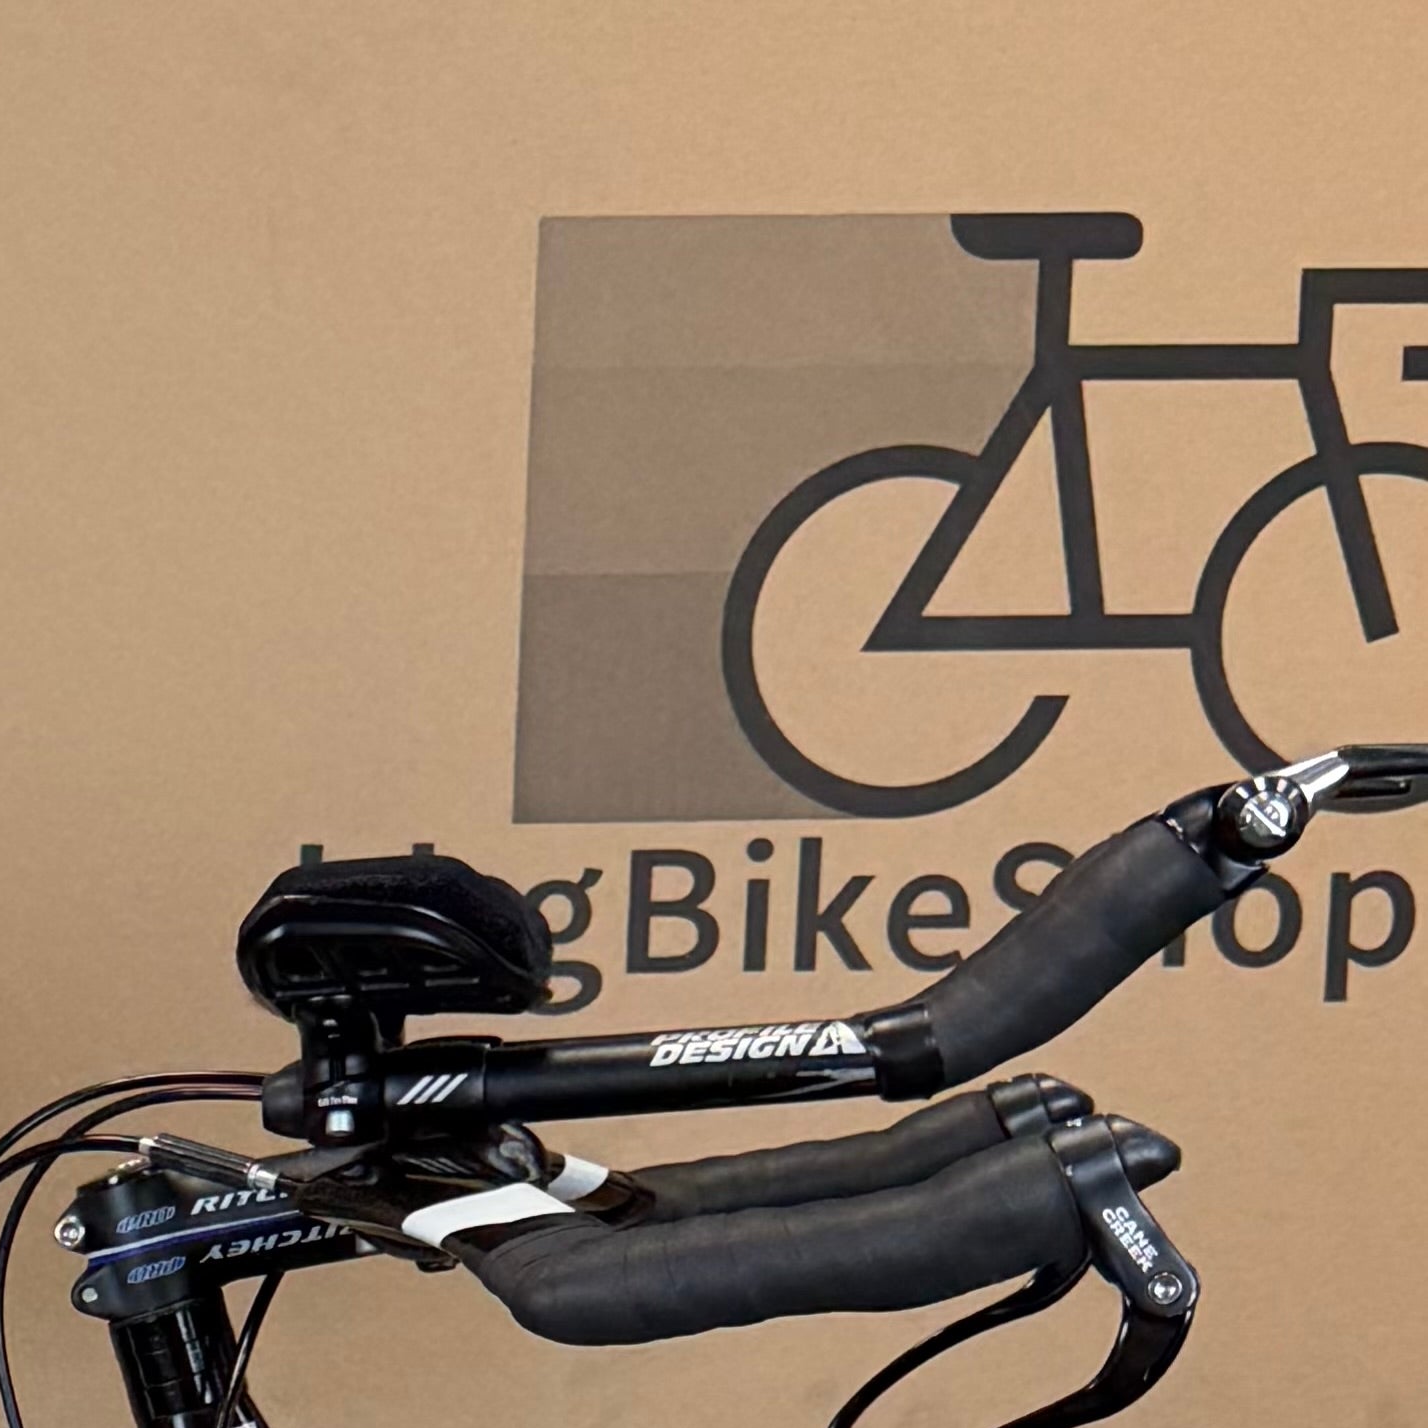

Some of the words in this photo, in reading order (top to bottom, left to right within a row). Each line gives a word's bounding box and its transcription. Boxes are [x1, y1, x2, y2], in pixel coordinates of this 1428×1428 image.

[649, 1034, 813, 1067] DESIGN
[1102, 1208, 1153, 1272] CREEK
[1115, 1206, 1158, 1260] CANE
